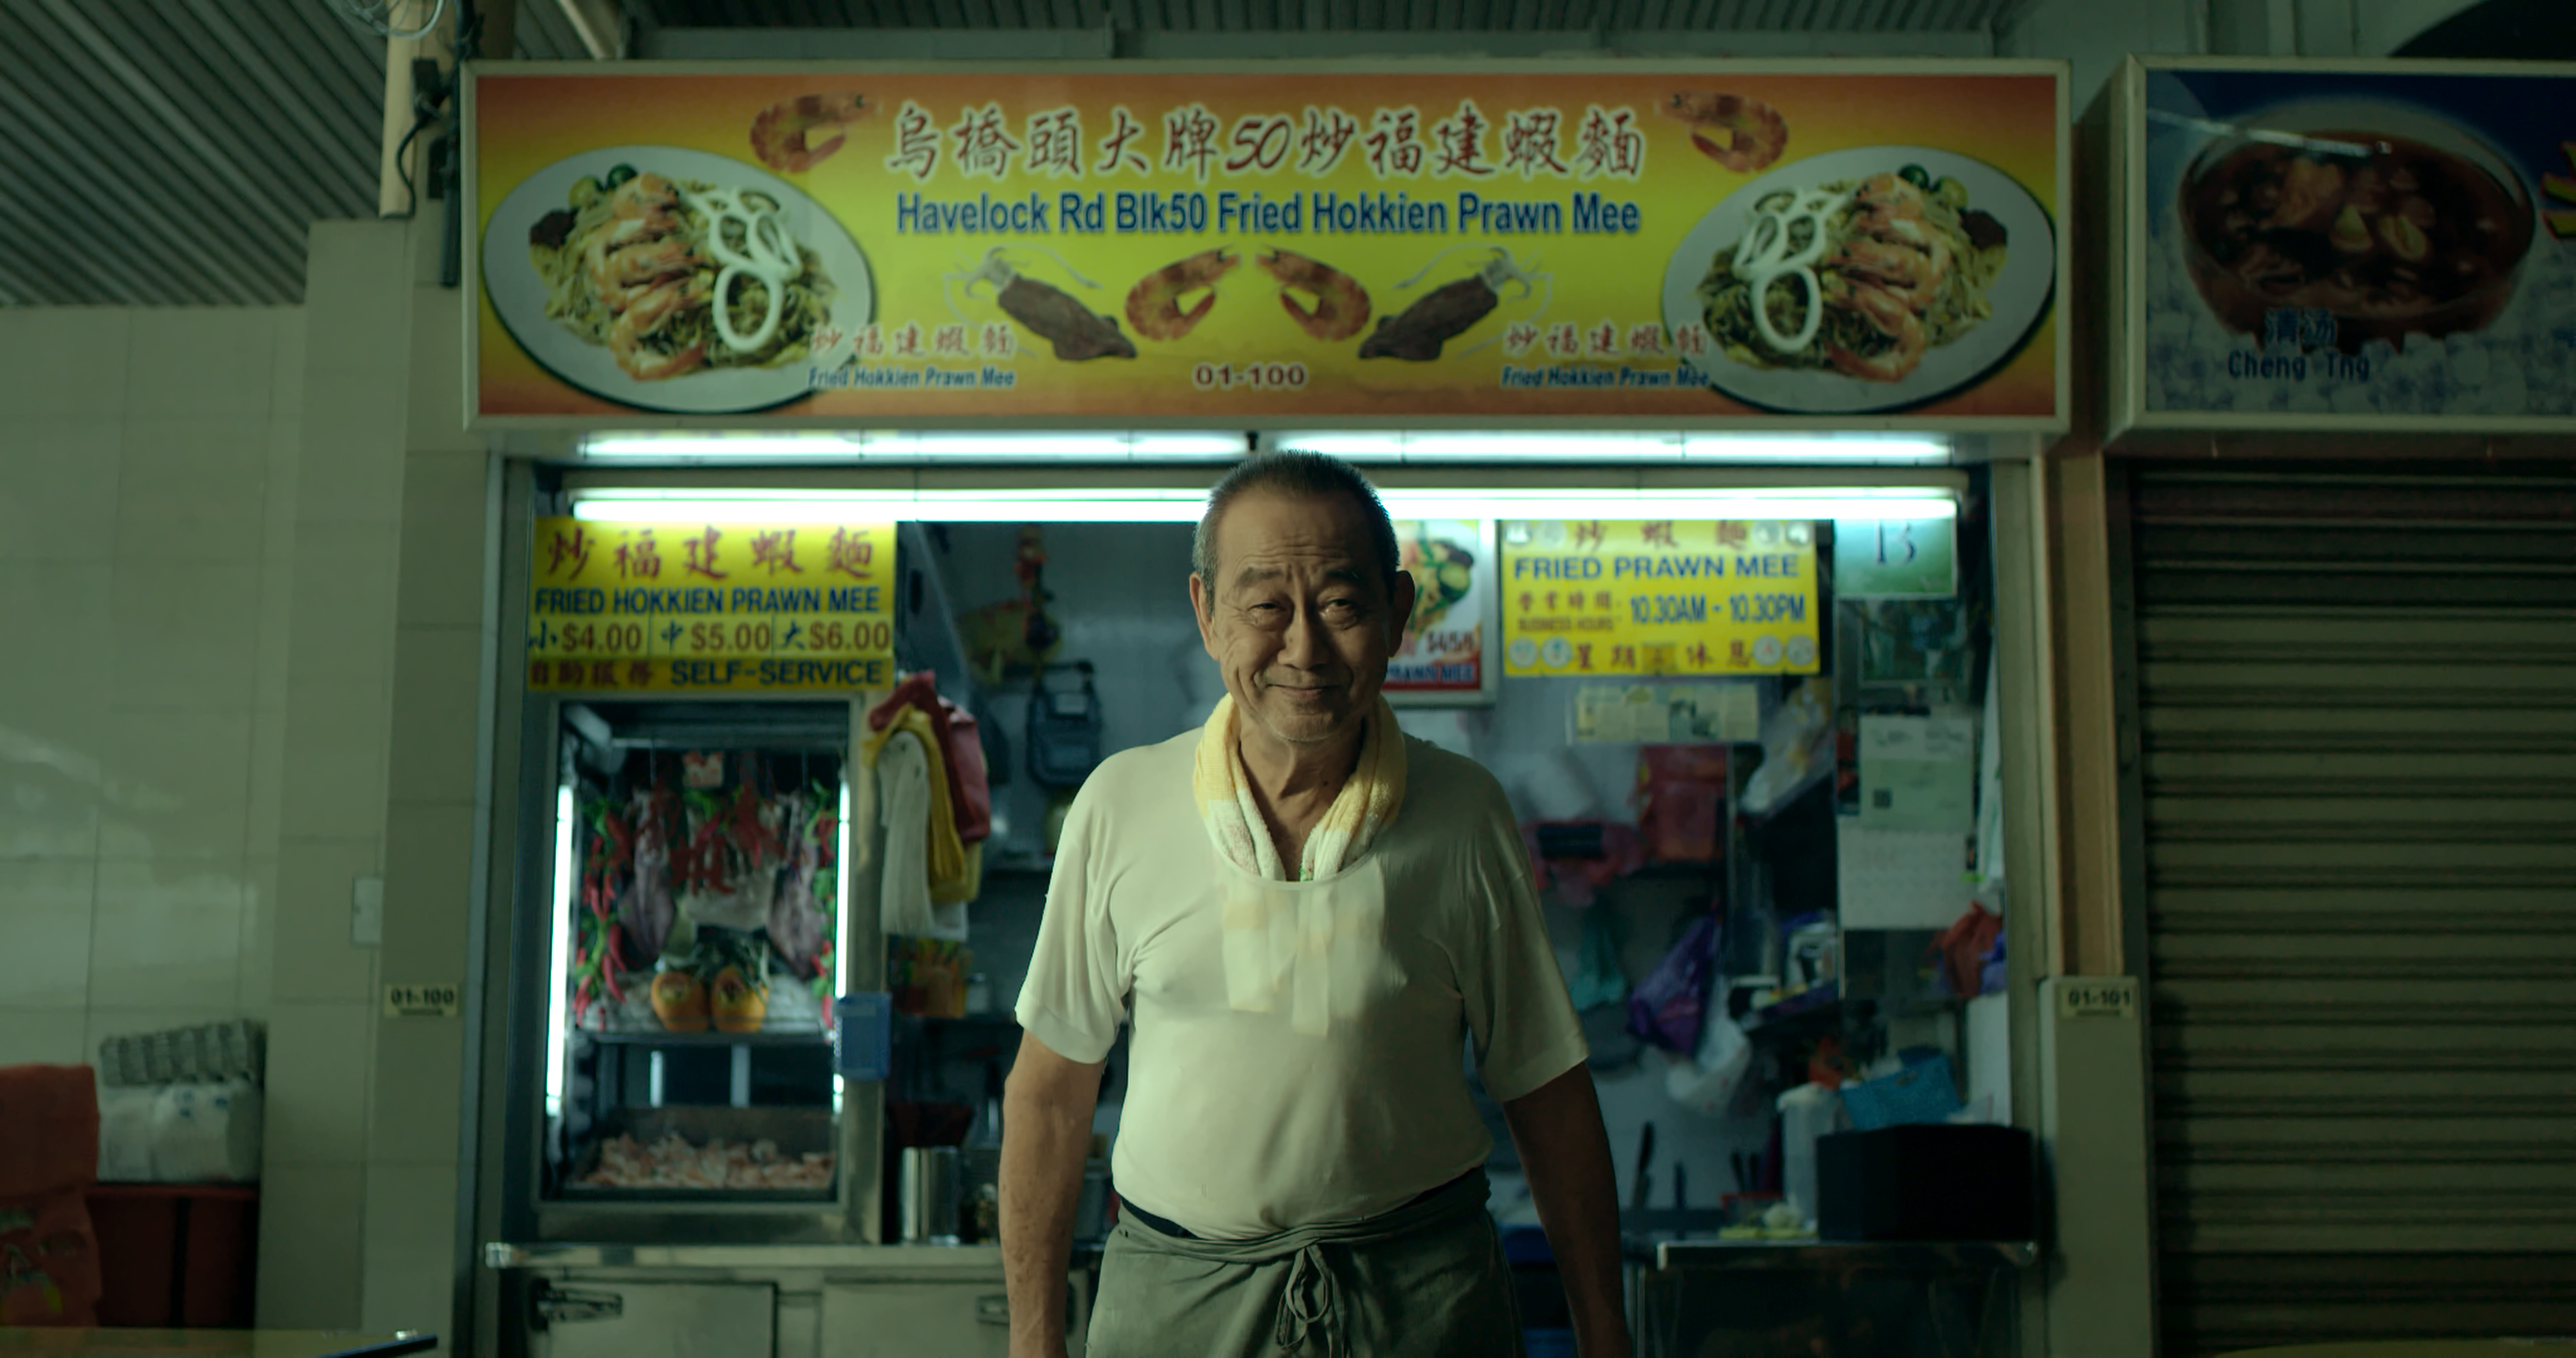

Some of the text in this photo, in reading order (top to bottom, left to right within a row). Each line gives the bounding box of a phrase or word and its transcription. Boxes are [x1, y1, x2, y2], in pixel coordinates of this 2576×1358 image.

[896, 192, 1641, 233] Havelock Rd Blk50 Fried Hokkien Prawn Mee
[808, 365, 1016, 387] Fried Hokkien Prawn Mee
[1196, 364, 1305, 385] 01-100
[1501, 365, 1709, 387] Fried Hokkien Prawn Mee
[2229, 349, 2370, 381] Cheng Tng
[1514, 553, 1800, 580] FRIED PRAWN MEE
[535, 585, 880, 615] FRIED HOKKIEN PRAWN MEE
[1630, 593, 1707, 624] 10.30AM
[1729, 593, 1806, 624] 10.30PM
[562, 621, 642, 651] $4.00
[660, 619, 684, 652] 中
[691, 621, 770, 651] $5.00
[782, 619, 806, 649] 大
[809, 620, 891, 651] $6.00
[670, 659, 882, 686] SELF-SERVICE
[390, 988, 455, 1006] 01-100
[2068, 988, 2131, 1006] 01-101
